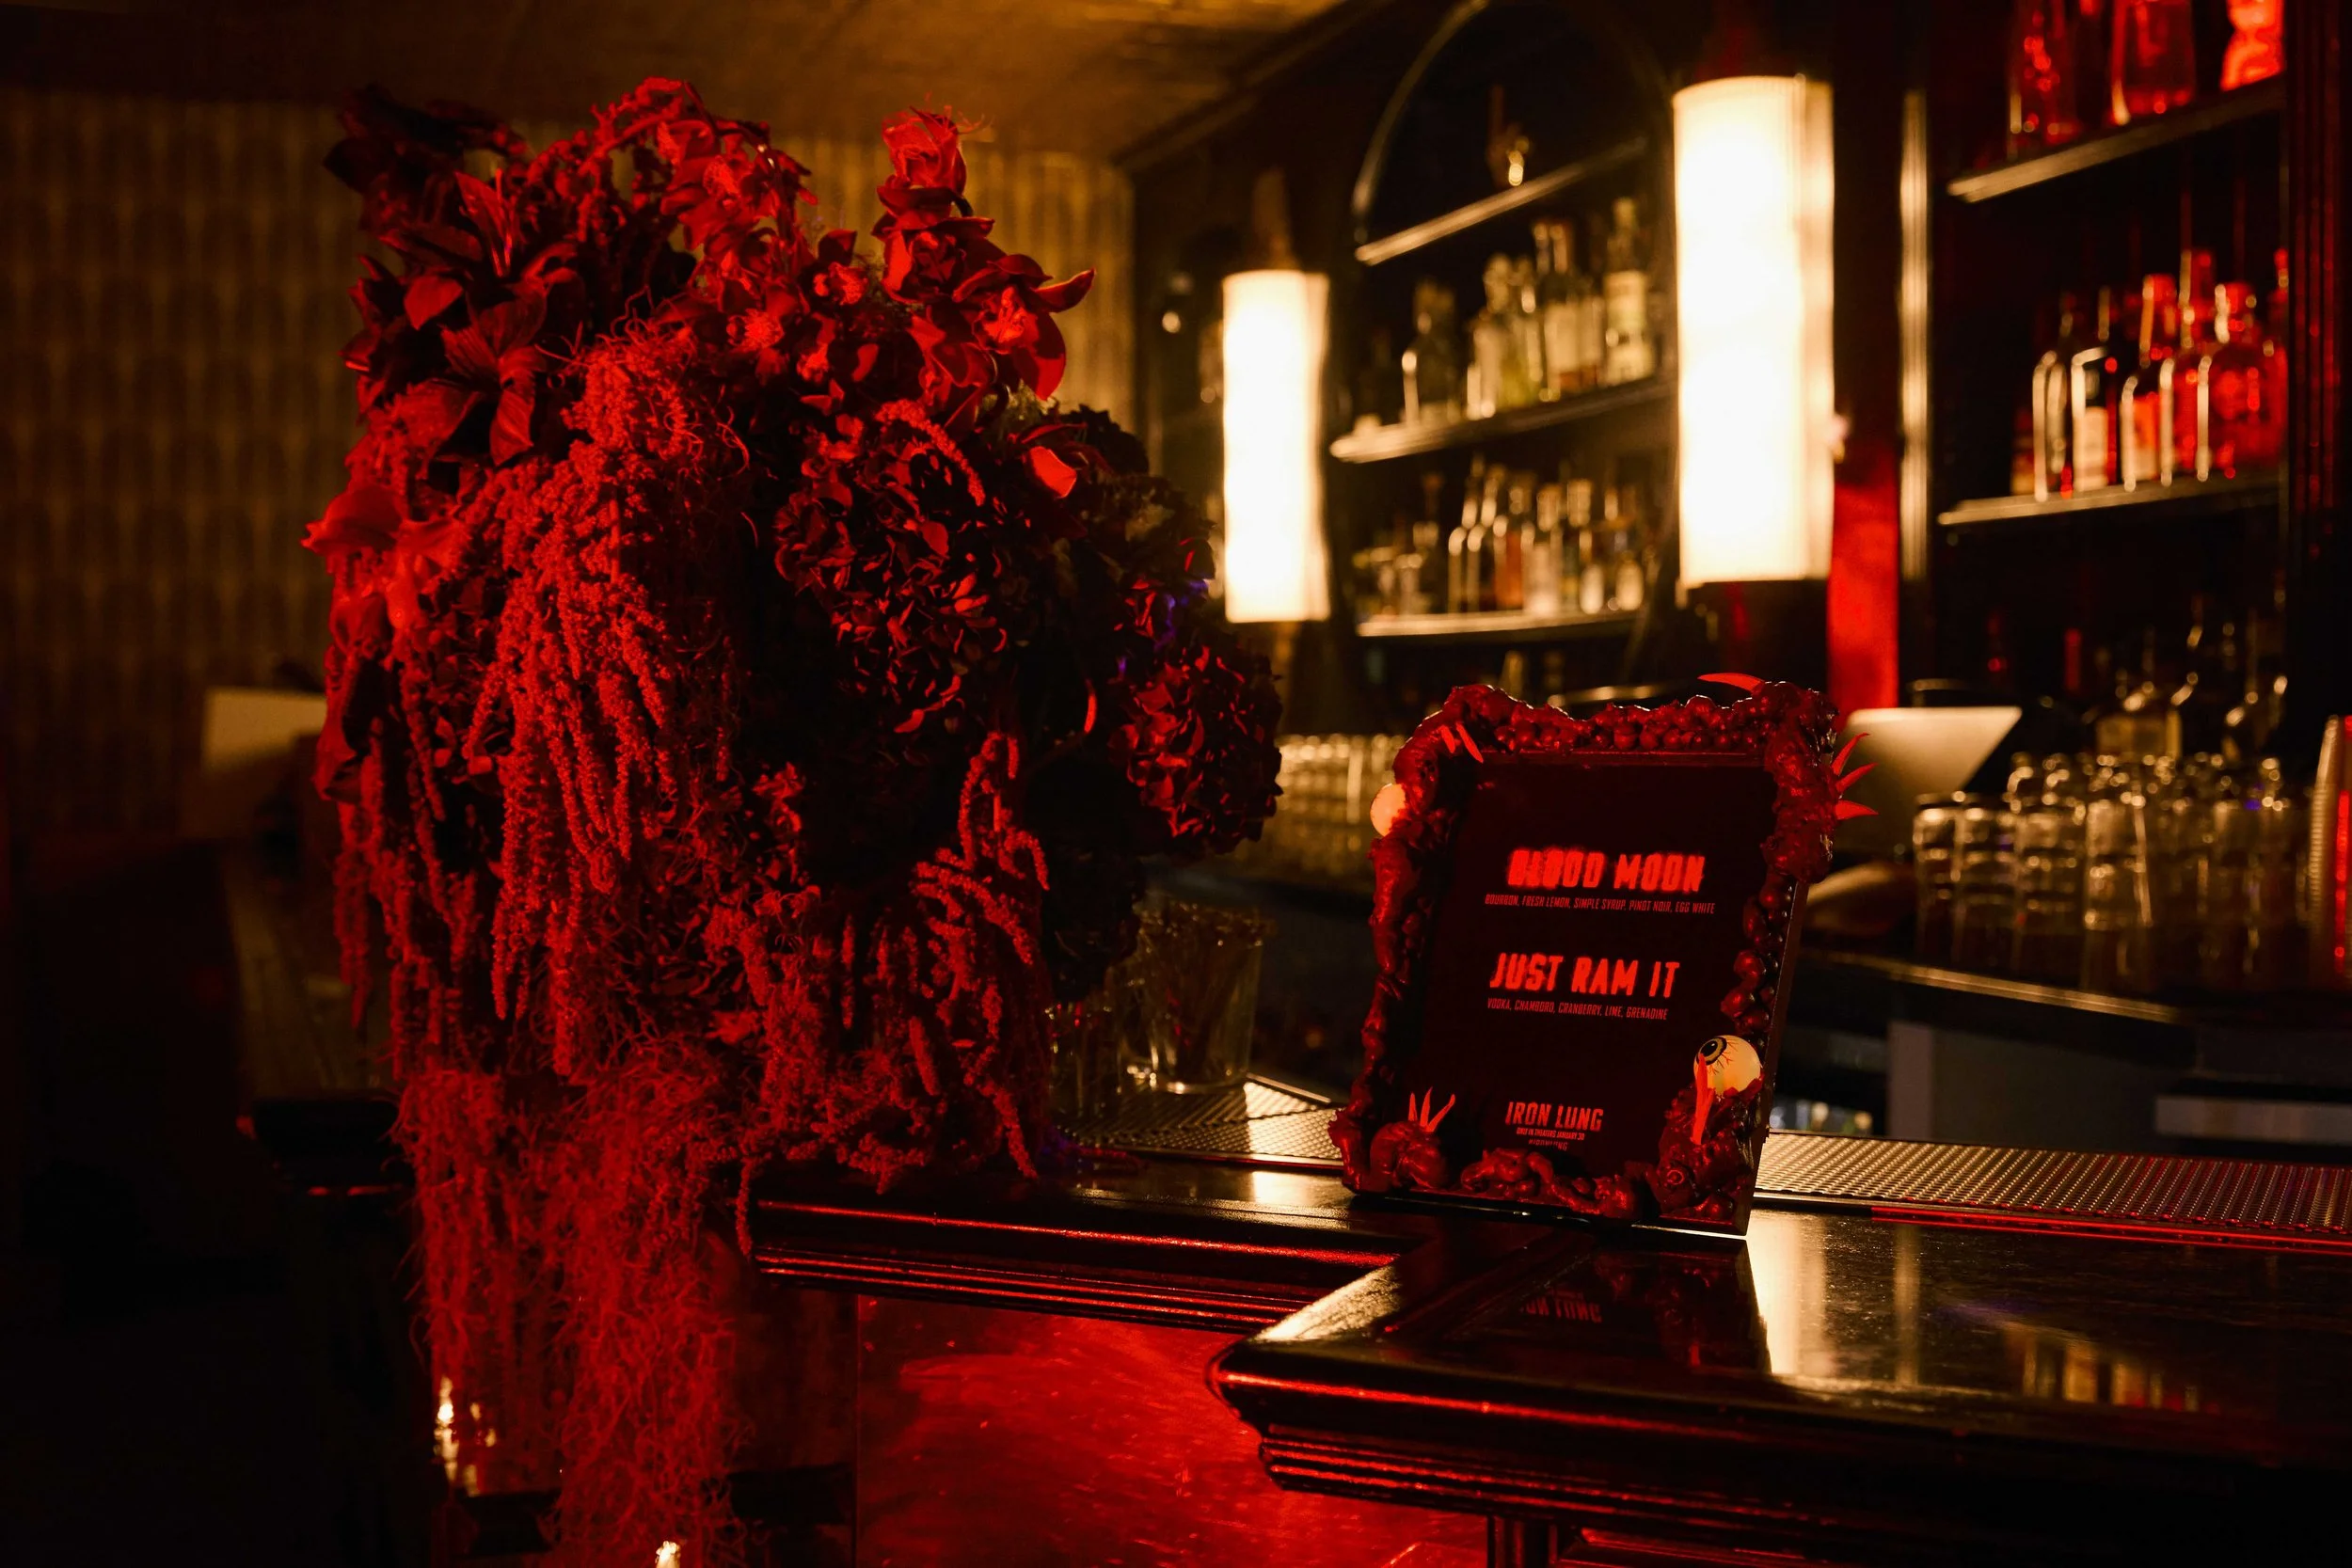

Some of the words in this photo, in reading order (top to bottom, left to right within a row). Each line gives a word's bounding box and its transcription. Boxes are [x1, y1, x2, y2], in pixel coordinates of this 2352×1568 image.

[1508, 848, 1604, 889] BLOOD
[1613, 853, 1706, 893] MOON
[1485, 894, 1518, 906] BOURBON,
[1522, 895, 1545, 907] FRESH
[1546, 896, 1570, 909] LEMON,
[1573, 897, 1600, 910] SIMPLE
[1629, 899, 1652, 911] PINOT
[1653, 900, 1673, 913] NOIR,
[1676, 901, 1691, 913] EGG
[1692, 902, 1715, 914] WHITE
[1490, 952, 1564, 992] JUST
[1570, 956, 1639, 996] RAM
[1648, 961, 1680, 999] IT
[1487, 997, 1511, 1010] VODKA,
[1514, 999, 1555, 1014] CHAMBORD,
[1558, 1002, 1602, 1017] CRANBERRY,
[1626, 1006, 1669, 1021] GRENADINE
[1505, 1101, 1551, 1127] IRON
[1555, 1104, 1604, 1132] LUNG
